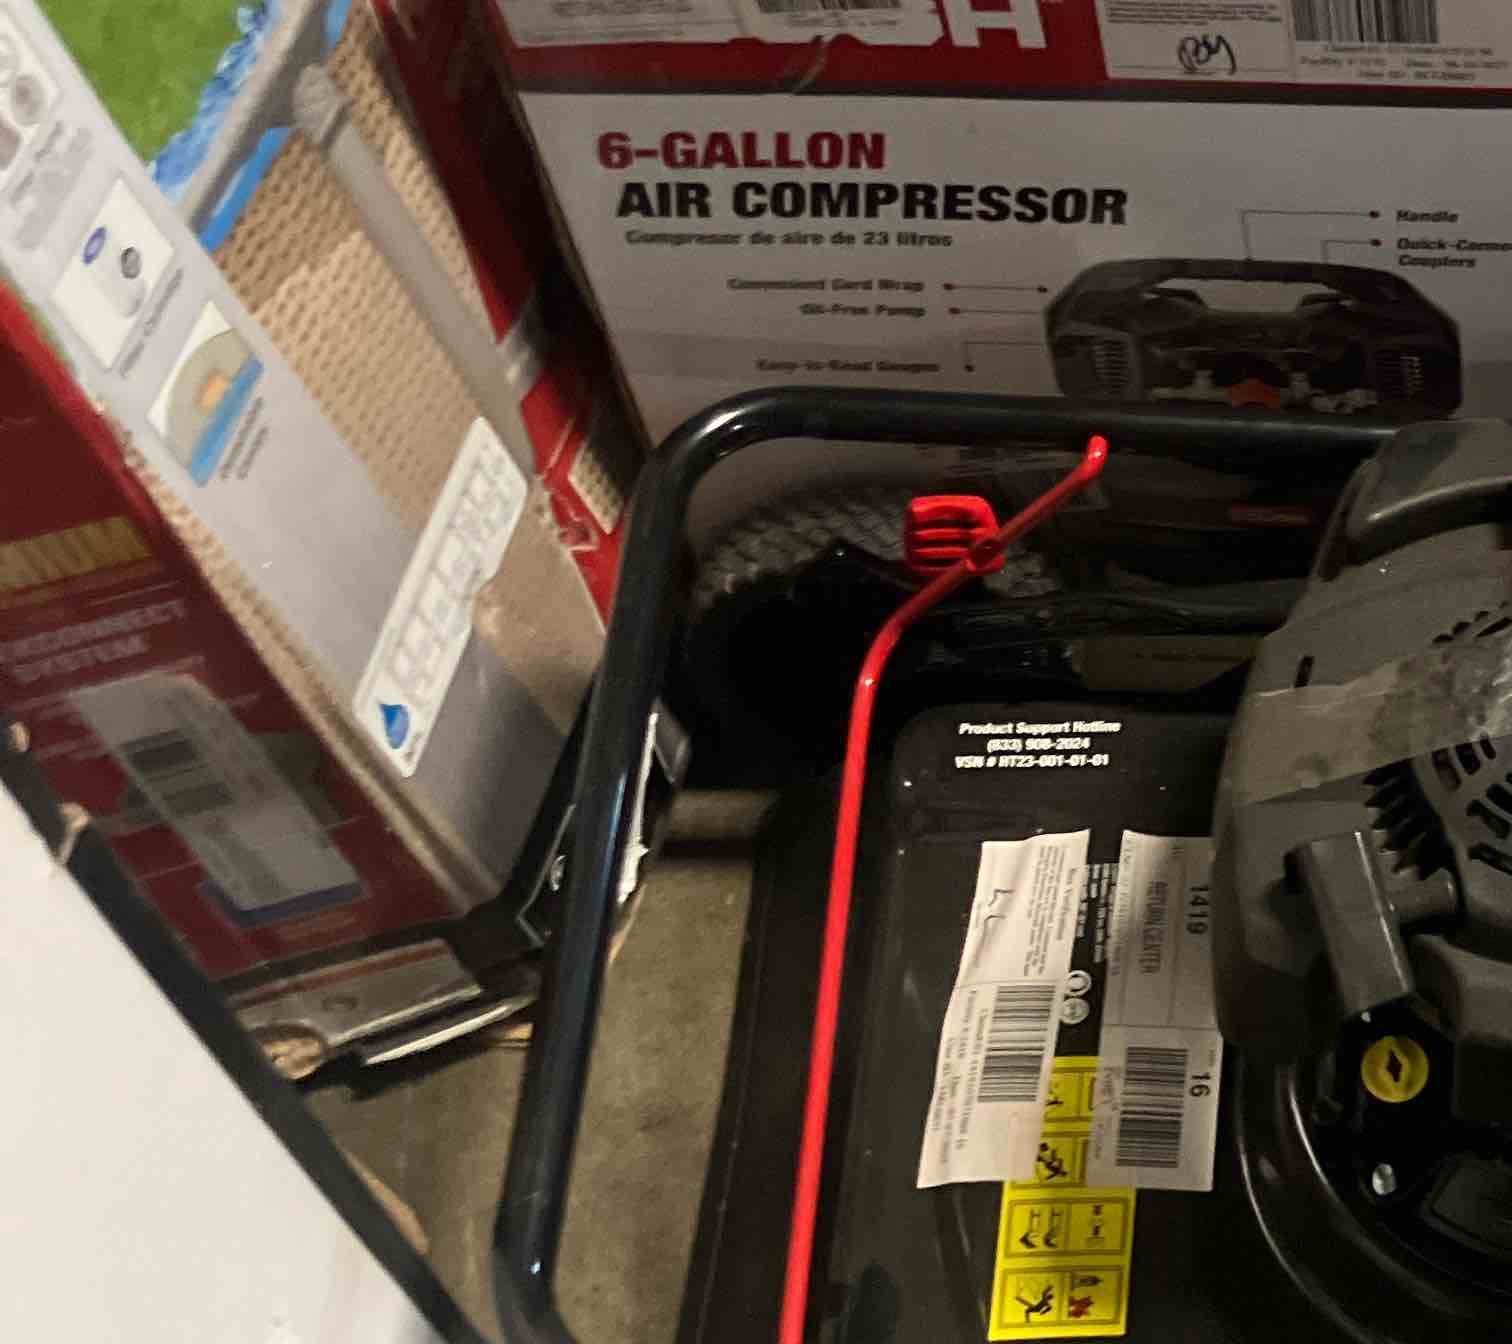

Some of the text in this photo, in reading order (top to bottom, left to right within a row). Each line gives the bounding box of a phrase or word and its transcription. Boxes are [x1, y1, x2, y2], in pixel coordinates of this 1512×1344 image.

[597, 130, 887, 171] 6-GALLON
[615, 180, 1129, 226] AIR COMPRESSOR
[749, 231, 775, 246] de
[830, 231, 856, 246] de
[863, 230, 890, 247] 23
[958, 720, 1123, 736] Product Support Hotline
[1187, 884, 1210, 936] 1419
[1189, 1072, 1212, 1098] 16
